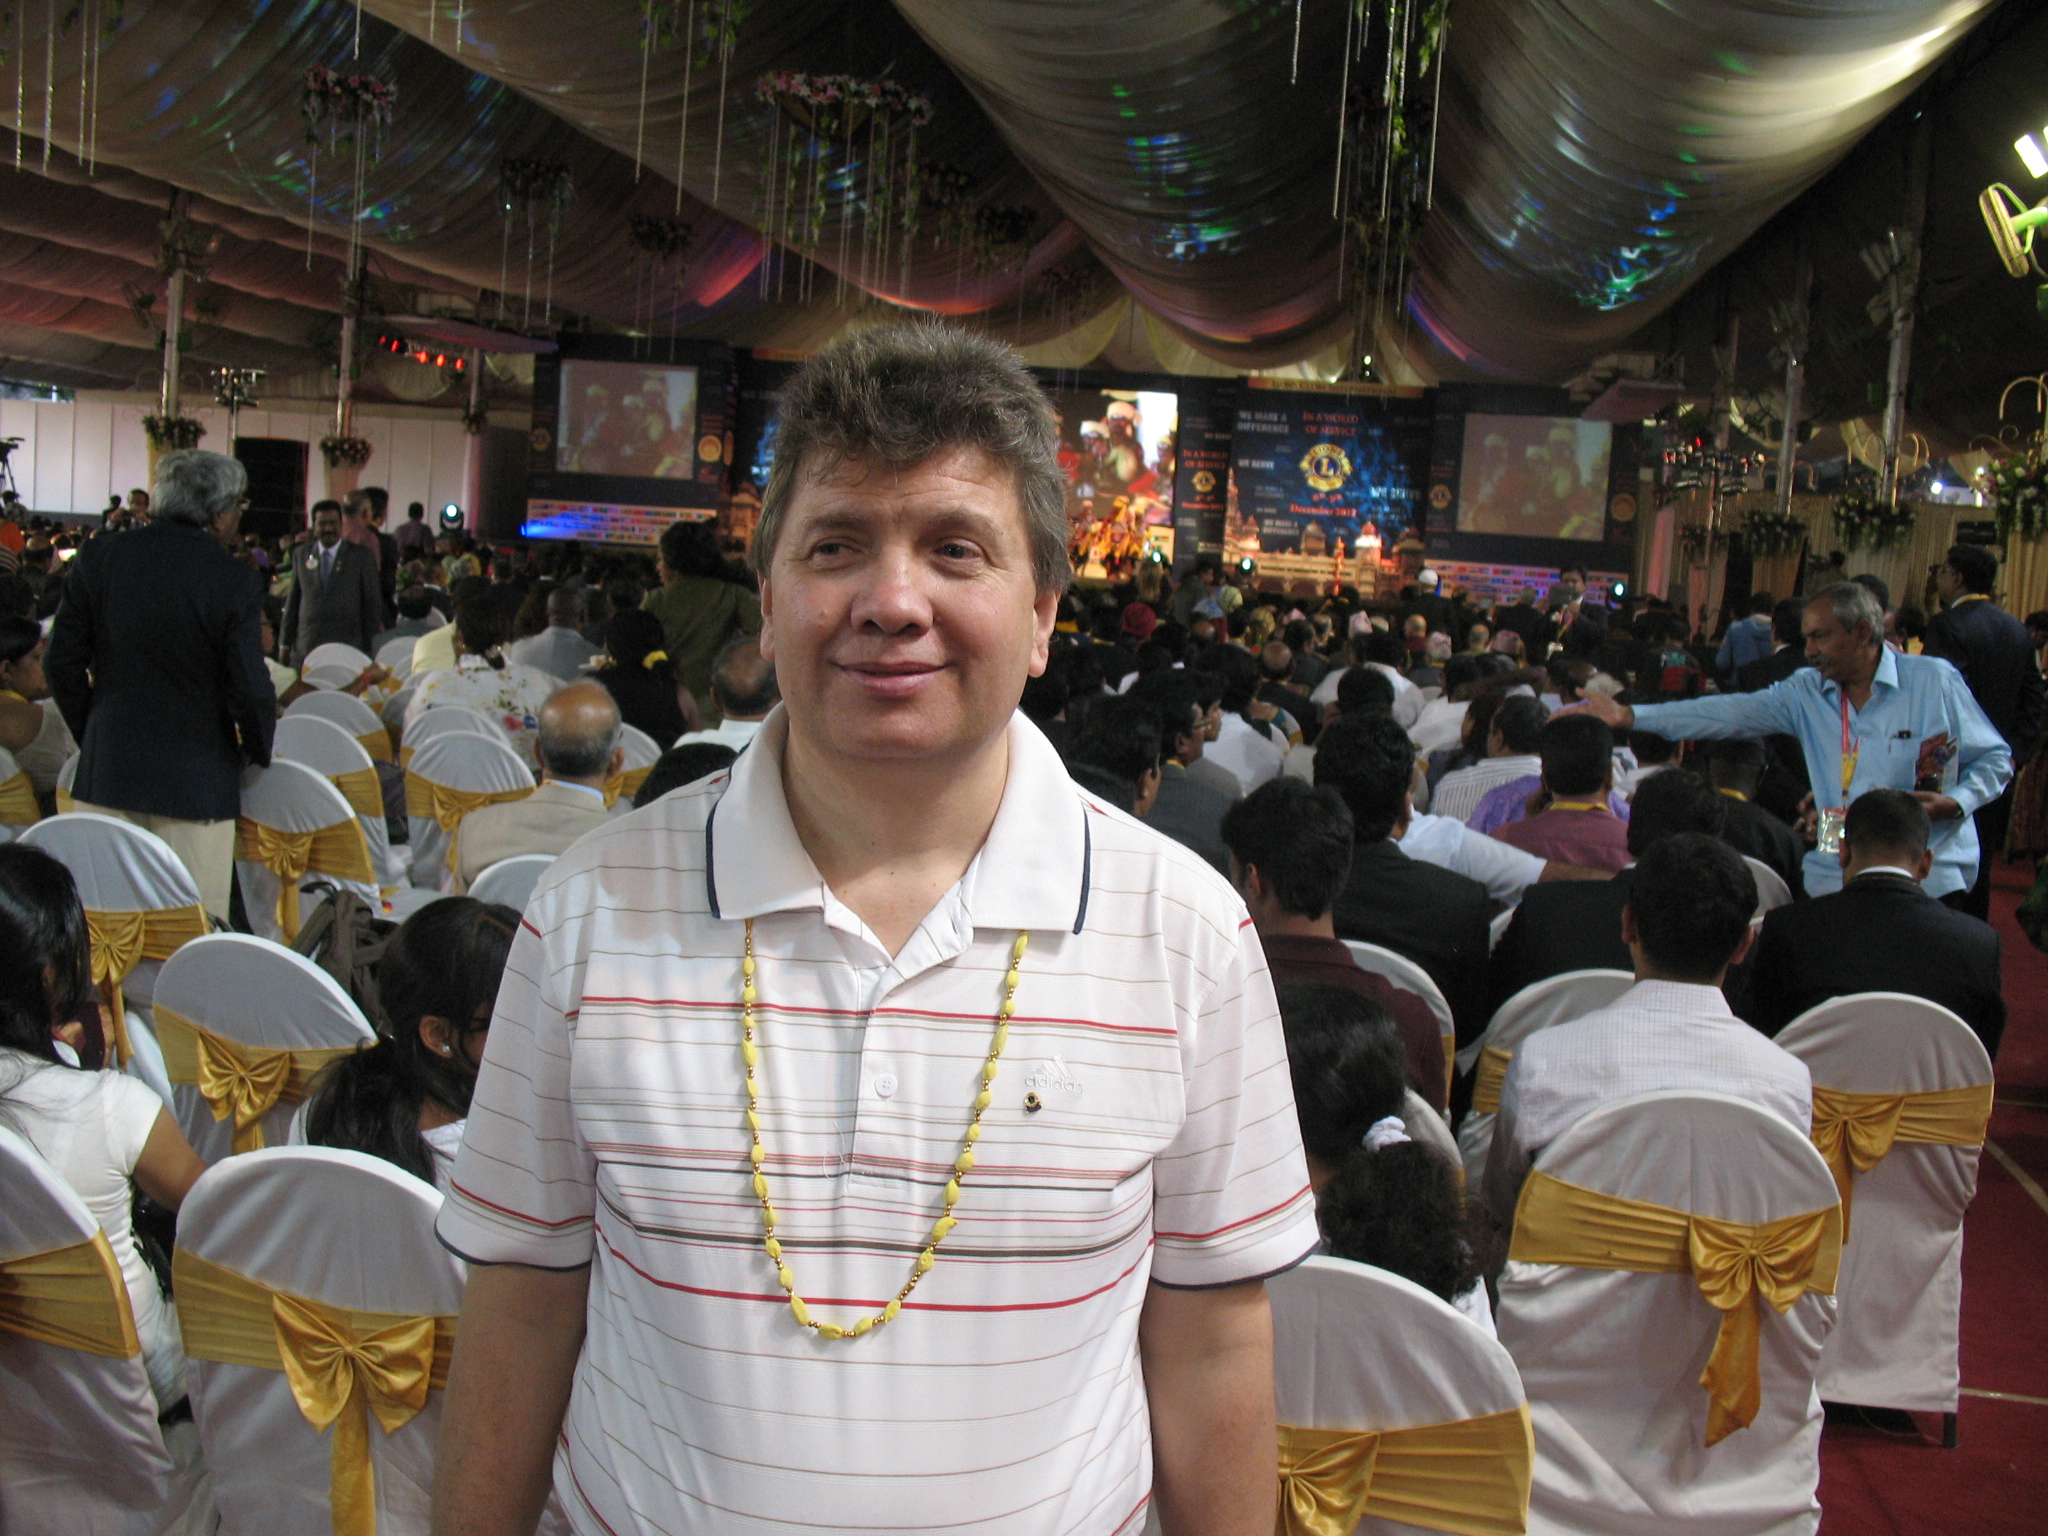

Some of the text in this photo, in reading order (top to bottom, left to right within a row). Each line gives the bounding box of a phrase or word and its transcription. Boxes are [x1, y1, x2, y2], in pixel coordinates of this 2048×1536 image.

[1238, 410, 1288, 421] WE MAKE A
[1302, 411, 1359, 424] IN A WORLD
[1237, 421, 1290, 433] DIFFERENCE
[1304, 424, 1357, 436] OF SERVICE
[1238, 458, 1250, 468] WE
[1320, 457, 1334, 476] L
[1289, 503, 1335, 515] December
[1335, 507, 1358, 517] 2012
[1024, 1074, 1084, 1095] adidas
